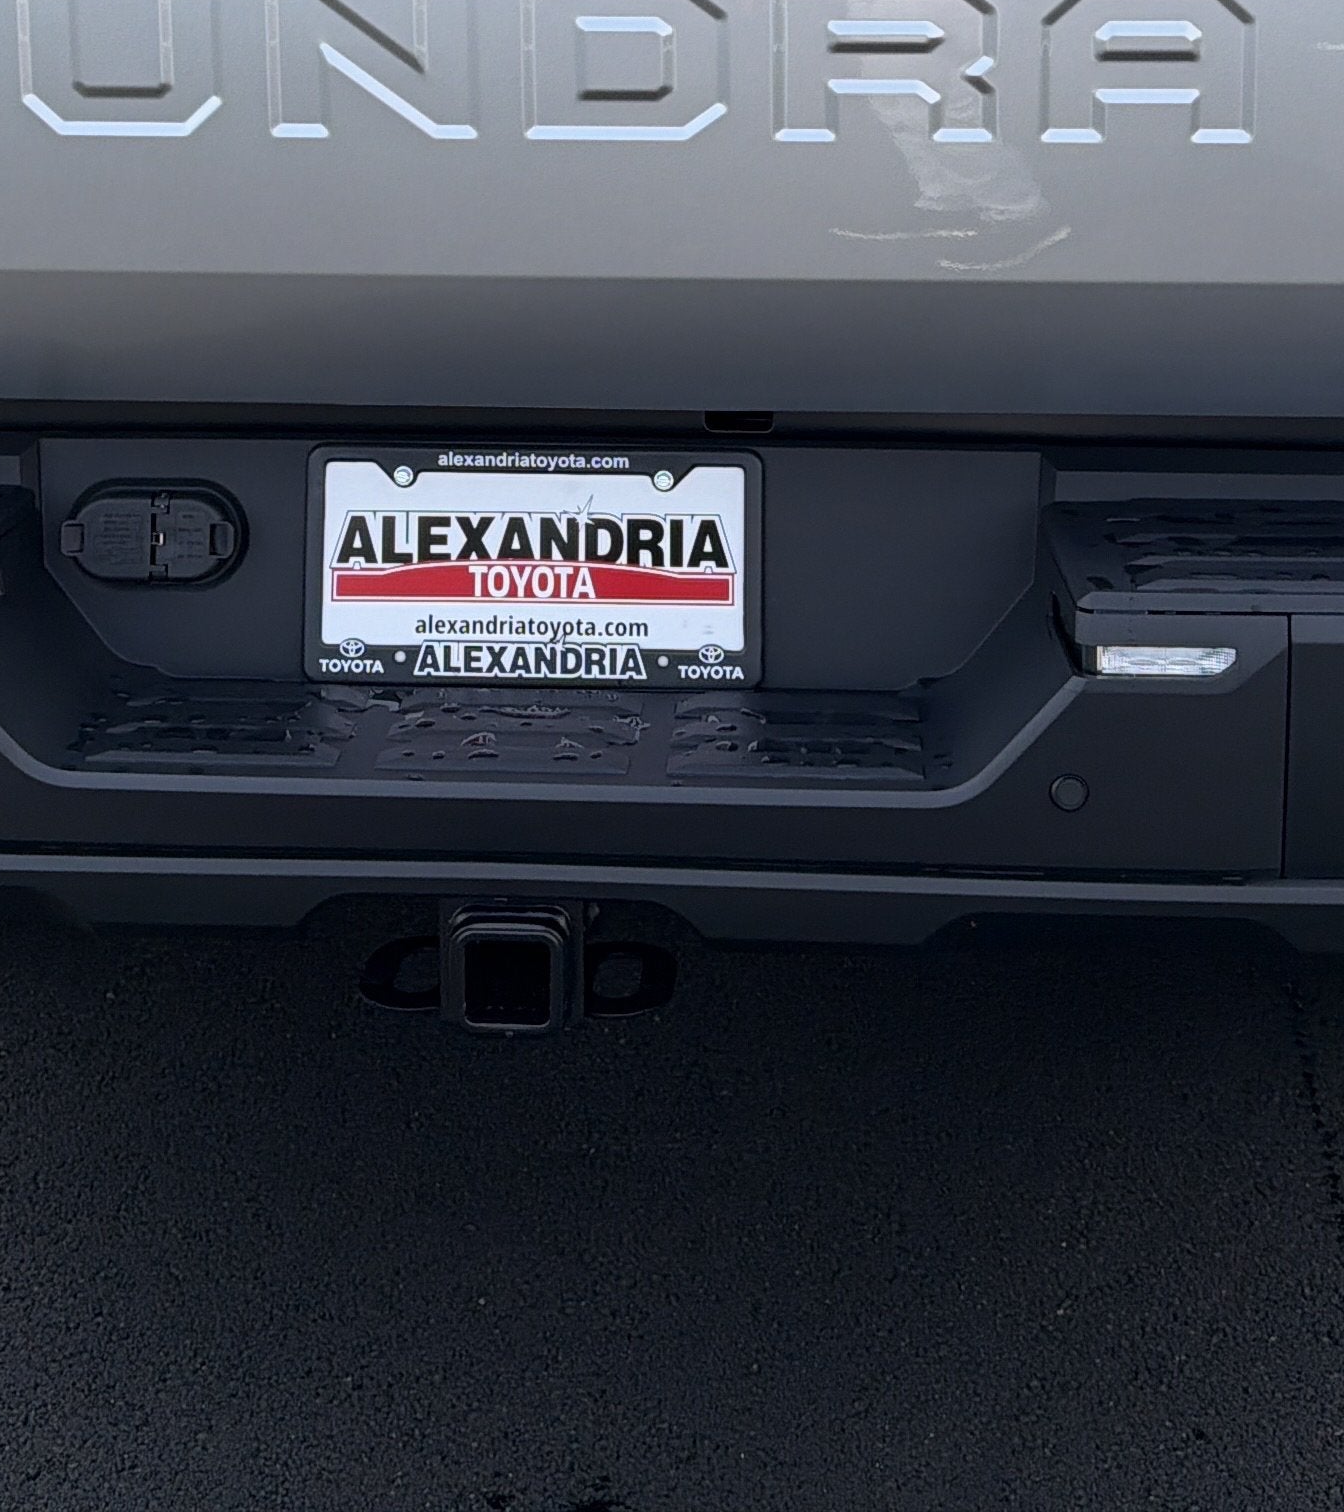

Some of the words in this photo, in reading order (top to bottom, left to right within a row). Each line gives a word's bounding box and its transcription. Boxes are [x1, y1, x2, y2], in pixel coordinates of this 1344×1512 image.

[437, 451, 630, 470] alexandriatoyota.com
[333, 513, 732, 570] ALEXANDRIA
[468, 565, 596, 599] TOYOTA
[414, 614, 649, 642] alexandriatoyota.com
[319, 658, 384, 675] TOYOTA
[414, 641, 647, 679] ALEXANDRIA
[678, 664, 744, 680] TOYOTA
